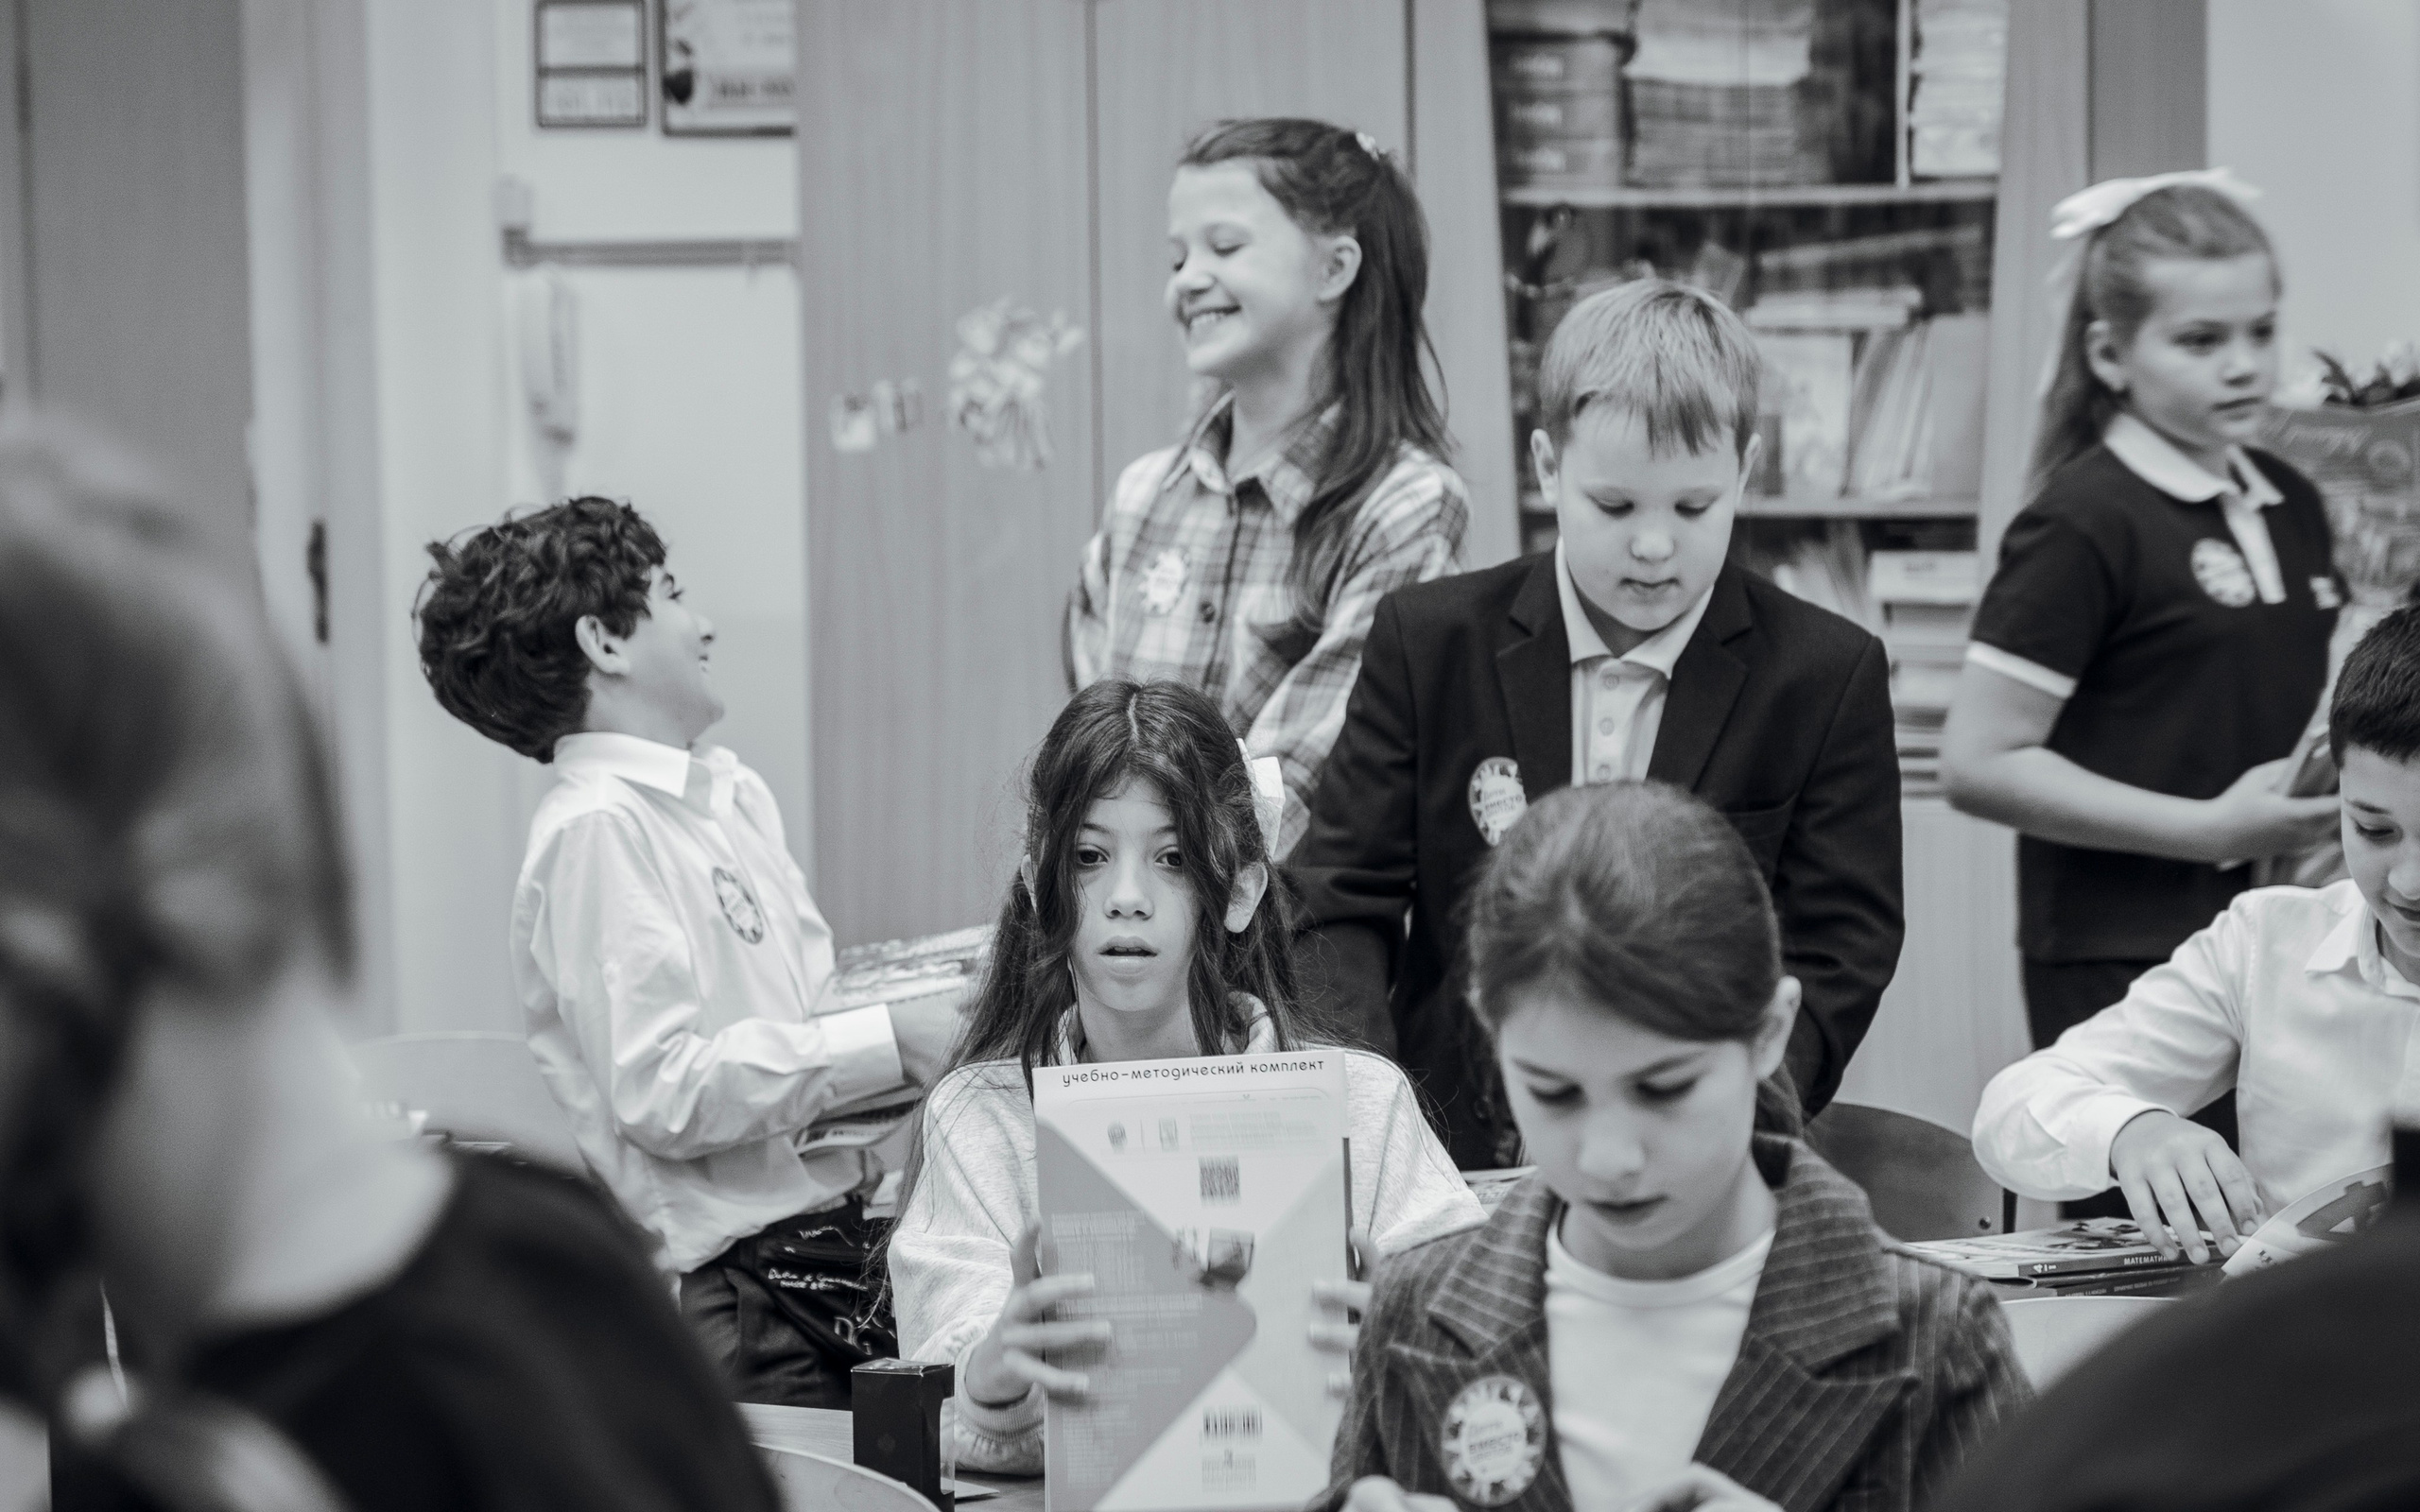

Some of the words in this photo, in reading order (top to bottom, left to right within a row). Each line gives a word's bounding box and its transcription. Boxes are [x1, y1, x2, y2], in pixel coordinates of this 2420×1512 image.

[1063, 1061, 1244, 1088] учебно-методический
[1250, 1060, 1324, 1074] комплект
[2124, 1255, 2166, 1265] МАТЕМАТИ
